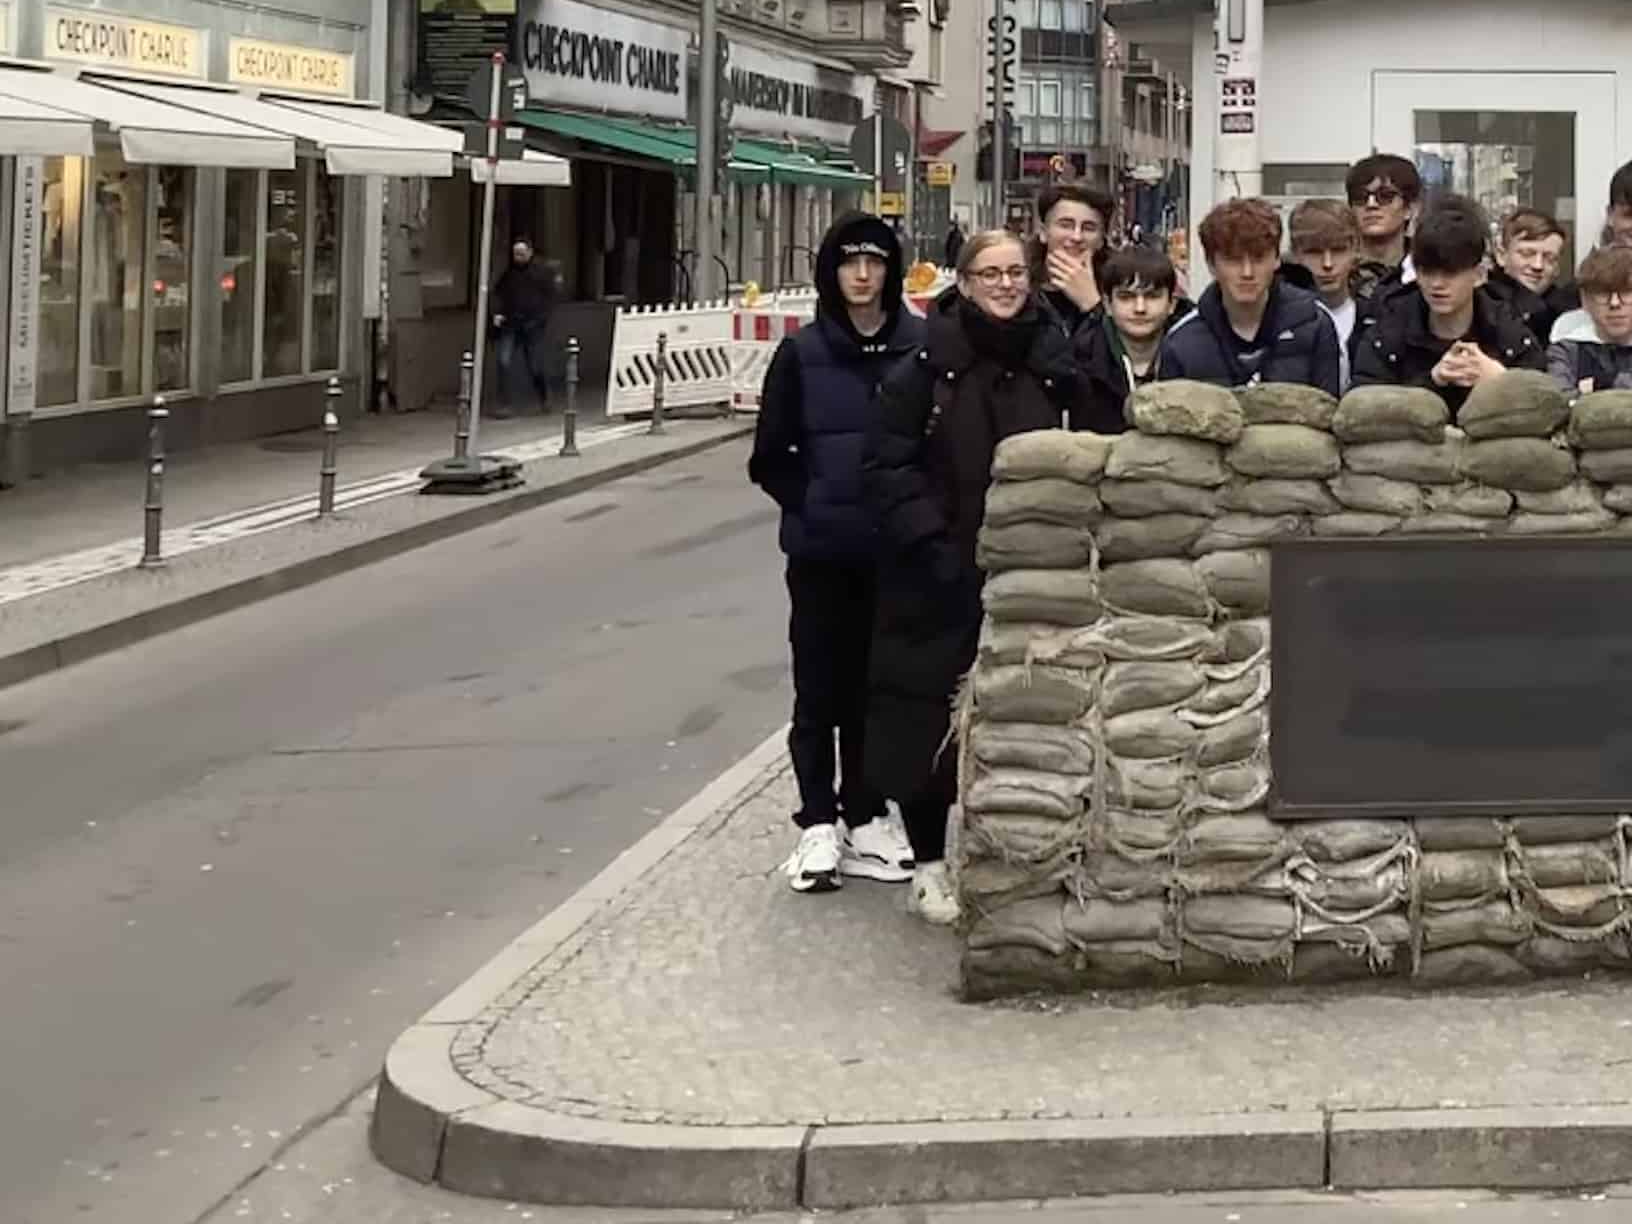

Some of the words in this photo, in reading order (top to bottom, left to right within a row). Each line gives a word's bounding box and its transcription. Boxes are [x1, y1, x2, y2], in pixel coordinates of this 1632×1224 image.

[56, 17, 136, 58] CHECKPOINT
[139, 30, 189, 69] CHARLIE
[236, 46, 299, 79] CHECKPOINT
[301, 54, 340, 88] CHARLIE
[523, 20, 624, 86] CHECKPOINT
[626, 39, 680, 105] CHARLIE
